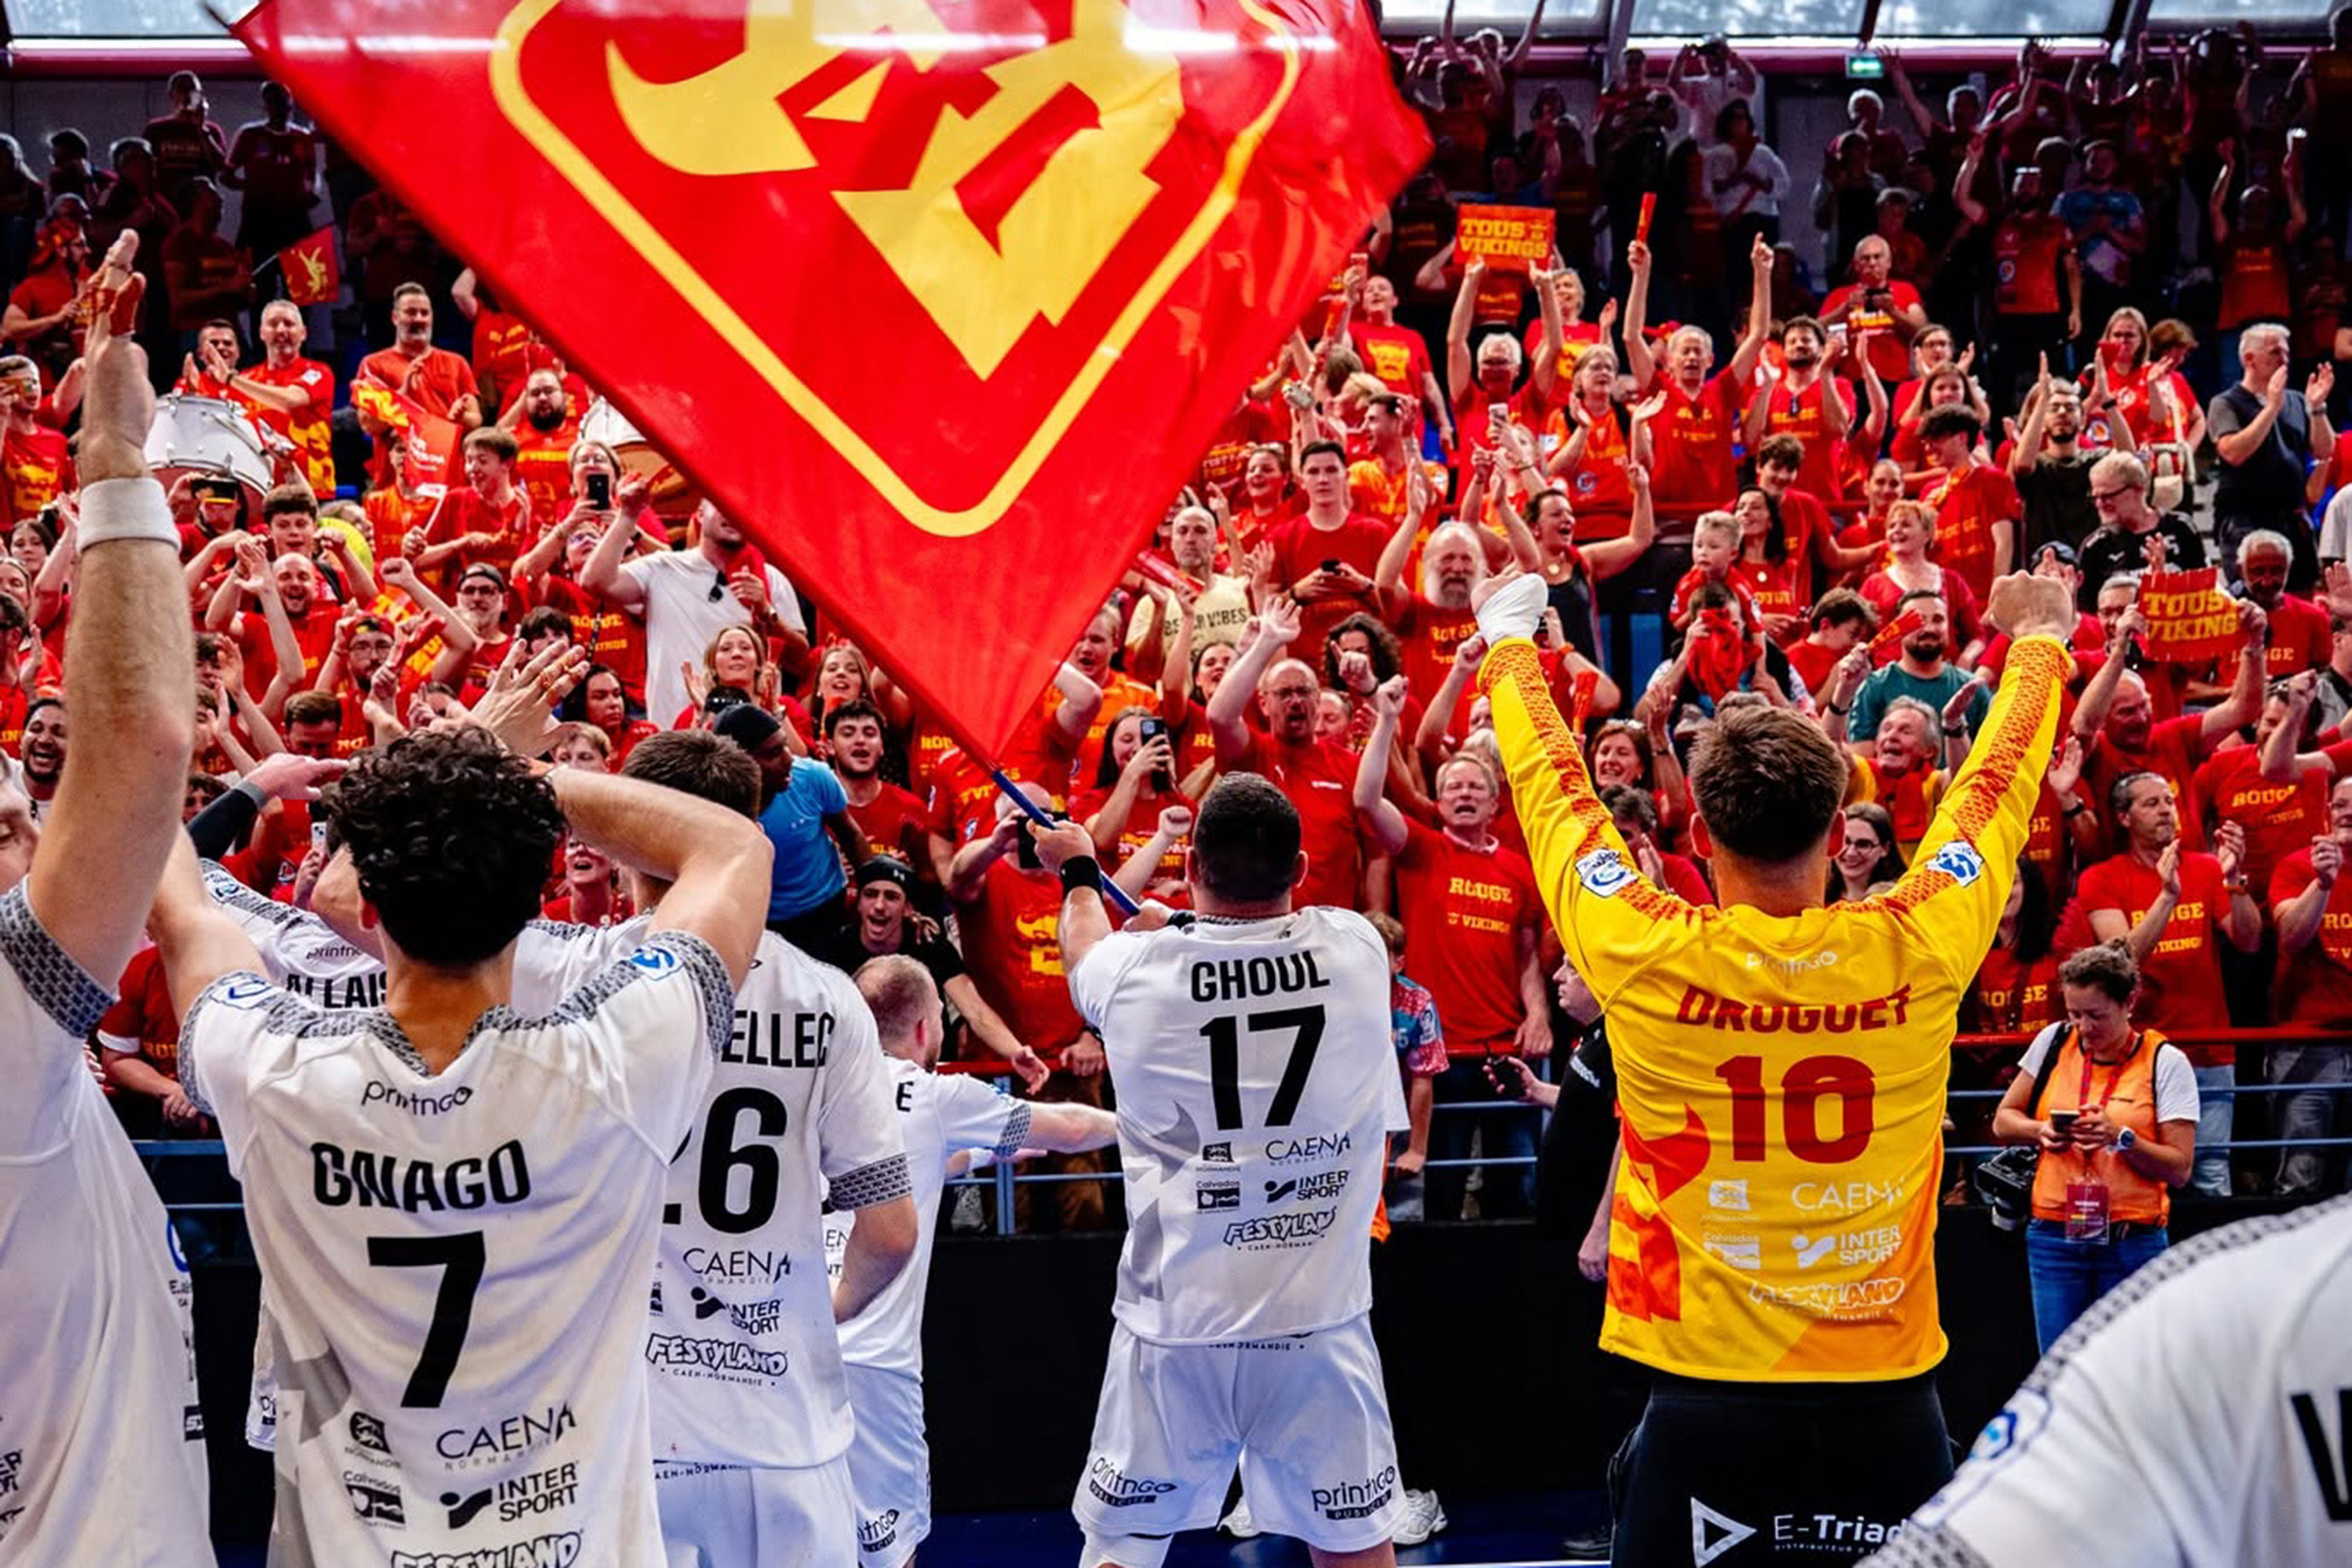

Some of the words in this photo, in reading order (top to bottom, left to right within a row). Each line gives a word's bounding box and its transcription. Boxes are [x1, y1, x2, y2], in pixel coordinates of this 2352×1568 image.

[1459, 236, 1548, 259] VIKINGS
[1460, 218, 1526, 238] TOUS
[2142, 590, 2224, 617] TOUS
[1191, 951, 1331, 1003] GHOUL
[1199, 1004, 1326, 1131] 17
[1715, 1054, 1877, 1164] 10
[1265, 1133, 1339, 1160] CAEN
[310, 1139, 531, 1213] GNAGO
[1298, 1170, 1349, 1189] INTER
[1839, 1225, 1902, 1248] INTER
[683, 1248, 772, 1277] CAEN
[367, 1230, 487, 1408] 7
[645, 1332, 789, 1377] FESTYLAND
[436, 1407, 555, 1459] CAEN
[498, 1462, 579, 1500] INTER
[498, 1483, 579, 1523] SPORT
